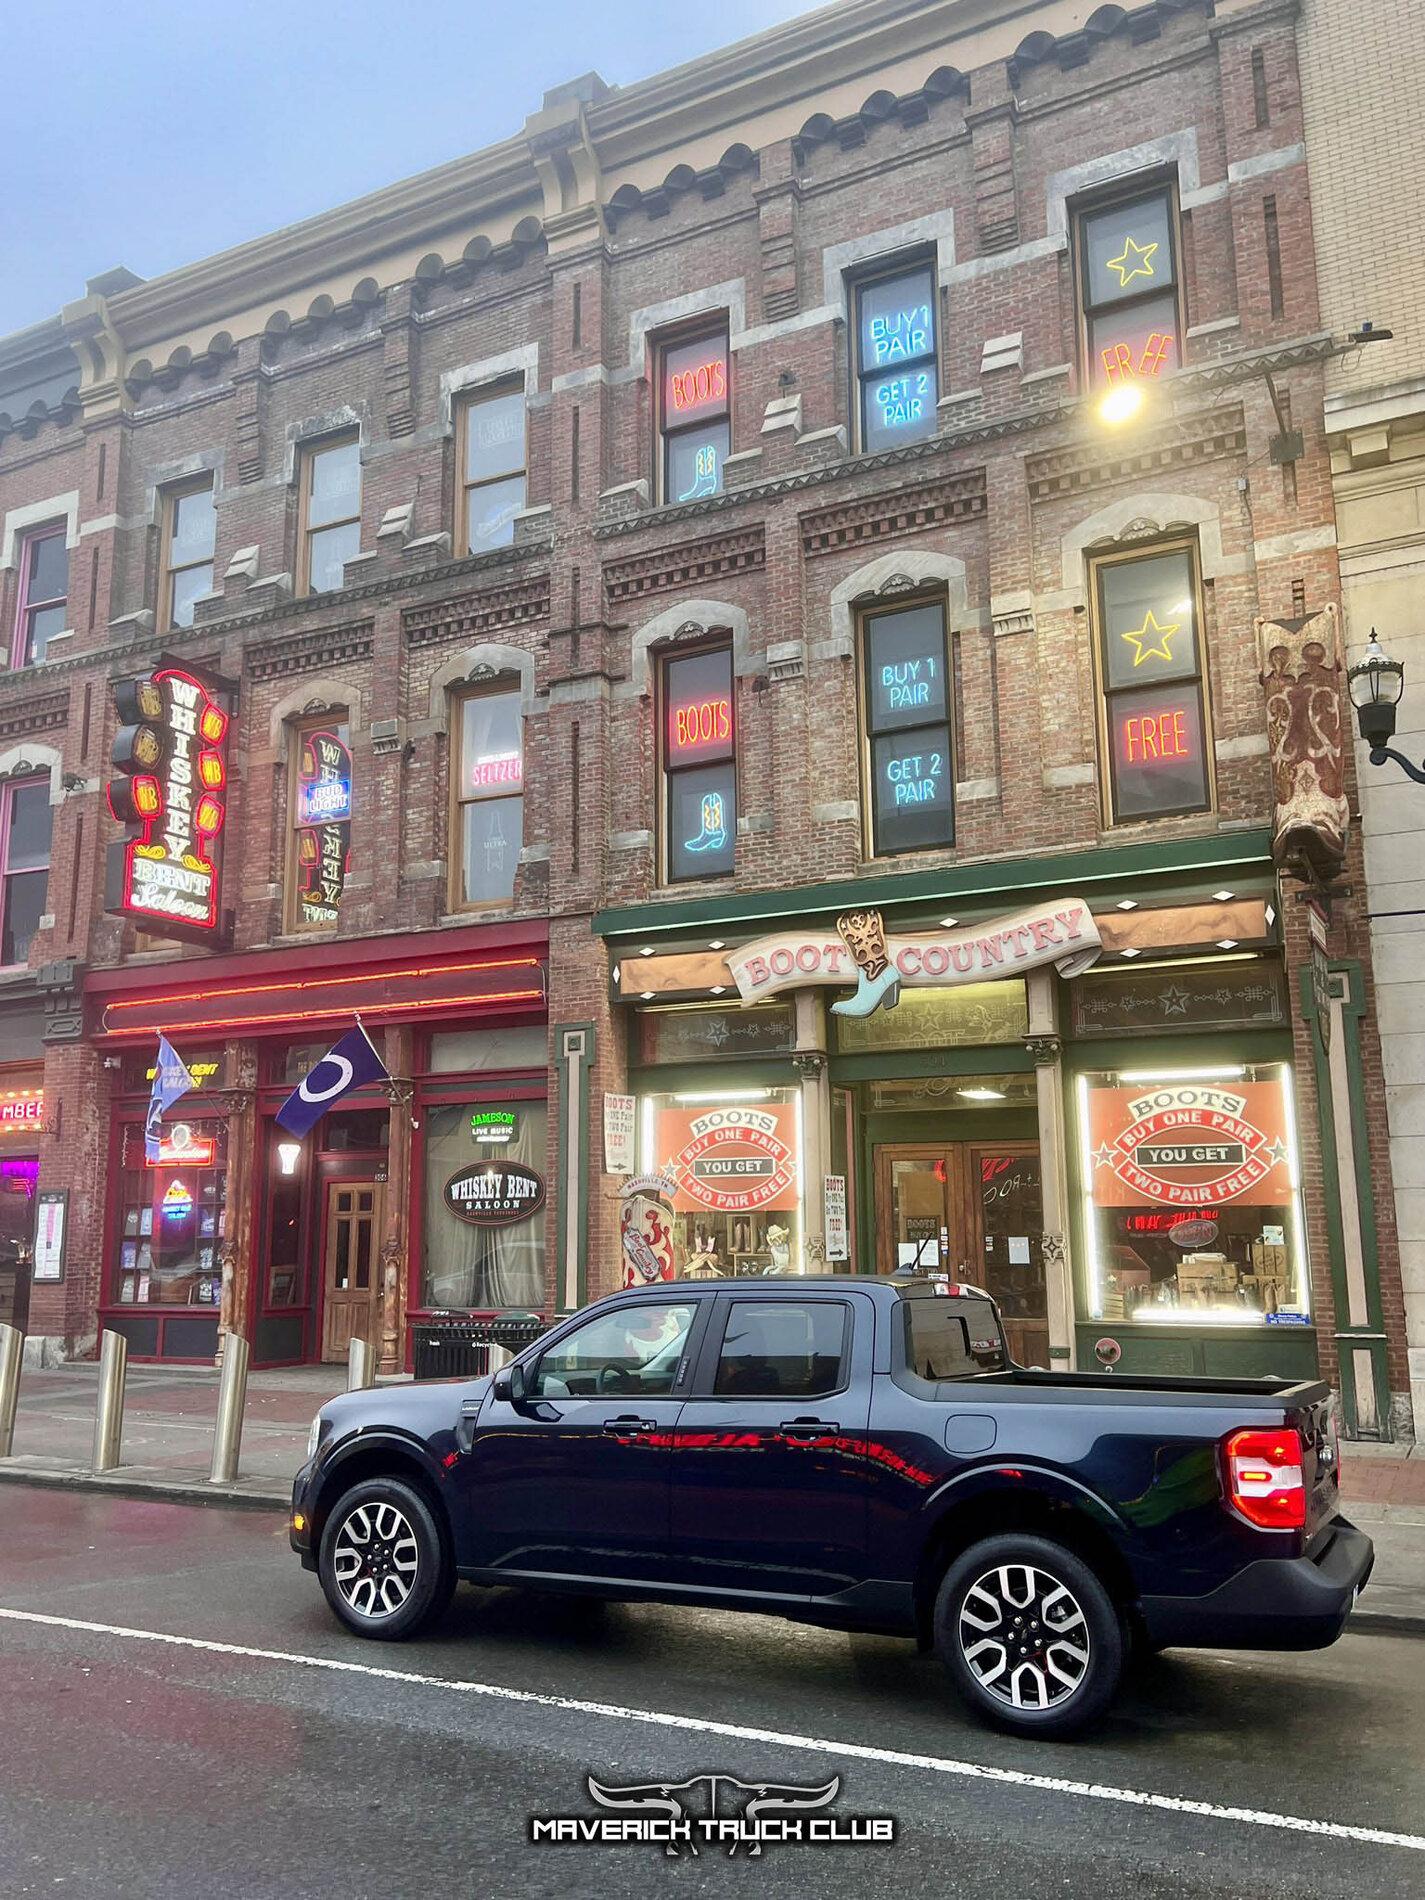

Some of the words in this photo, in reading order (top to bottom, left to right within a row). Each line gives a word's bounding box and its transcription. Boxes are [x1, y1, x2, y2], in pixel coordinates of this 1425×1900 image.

[869, 313, 912, 342] BUY
[920, 304, 930, 328] 1
[873, 328, 928, 364] PAIR
[1101, 332, 1175, 384] FREE
[670, 359, 725, 410] BOOTS
[876, 379, 911, 406] GET
[916, 372, 930, 396] 2
[883, 398, 923, 428] PAIR
[881, 661, 921, 687] BUY
[927, 657, 937, 679] 1
[889, 681, 930, 710] PAIR
[675, 699, 731, 747] BOOTS
[1125, 709, 1190, 763] FREE
[163, 677, 201, 862] WHISKEY
[203, 759, 222, 784] WB
[473, 759, 523, 786] SELTZER
[886, 756, 922, 783] GET
[928, 752, 943, 777] 2
[309, 794, 348, 813] LIGHT
[314, 784, 343, 799] BUD
[895, 776, 937, 806] PAIR
[132, 857, 211, 897] BENT
[130, 884, 209, 920] Saloon
[744, 942, 847, 987] BOOT
[896, 906, 1085, 977] COUNTRY
[471, 1111, 516, 1126] JAMESON
[1133, 1090, 1241, 1118] BOOTS
[471, 1128, 488, 1136] LIVE
[490, 1126, 514, 1135] MUSIC
[692, 1110, 775, 1137] BOOTS
[1121, 1121, 1156, 1148] BUY
[1163, 1111, 1203, 1126] ONE
[1211, 1113, 1253, 1144] PAIR
[683, 1137, 711, 1161] BUY
[714, 1129, 744, 1142] ONE
[749, 1130, 782, 1157] PAIR
[1148, 1148, 1187, 1163] YOU
[1190, 1147, 1229, 1162] GET
[702, 1161, 733, 1174] YOU
[735, 1160, 764, 1173] GET
[1124, 1167, 1163, 1195] TWO
[1168, 1186, 1212, 1202] PAIR
[1216, 1161, 1263, 1196] FREE
[450, 1173, 503, 1201] WHISKEY
[506, 1174, 539, 1199] BENT
[685, 1177, 713, 1203] TWO
[716, 1192, 750, 1208] PAIR
[752, 1172, 787, 1203] FREE
[465, 1199, 521, 1210] SALOON
